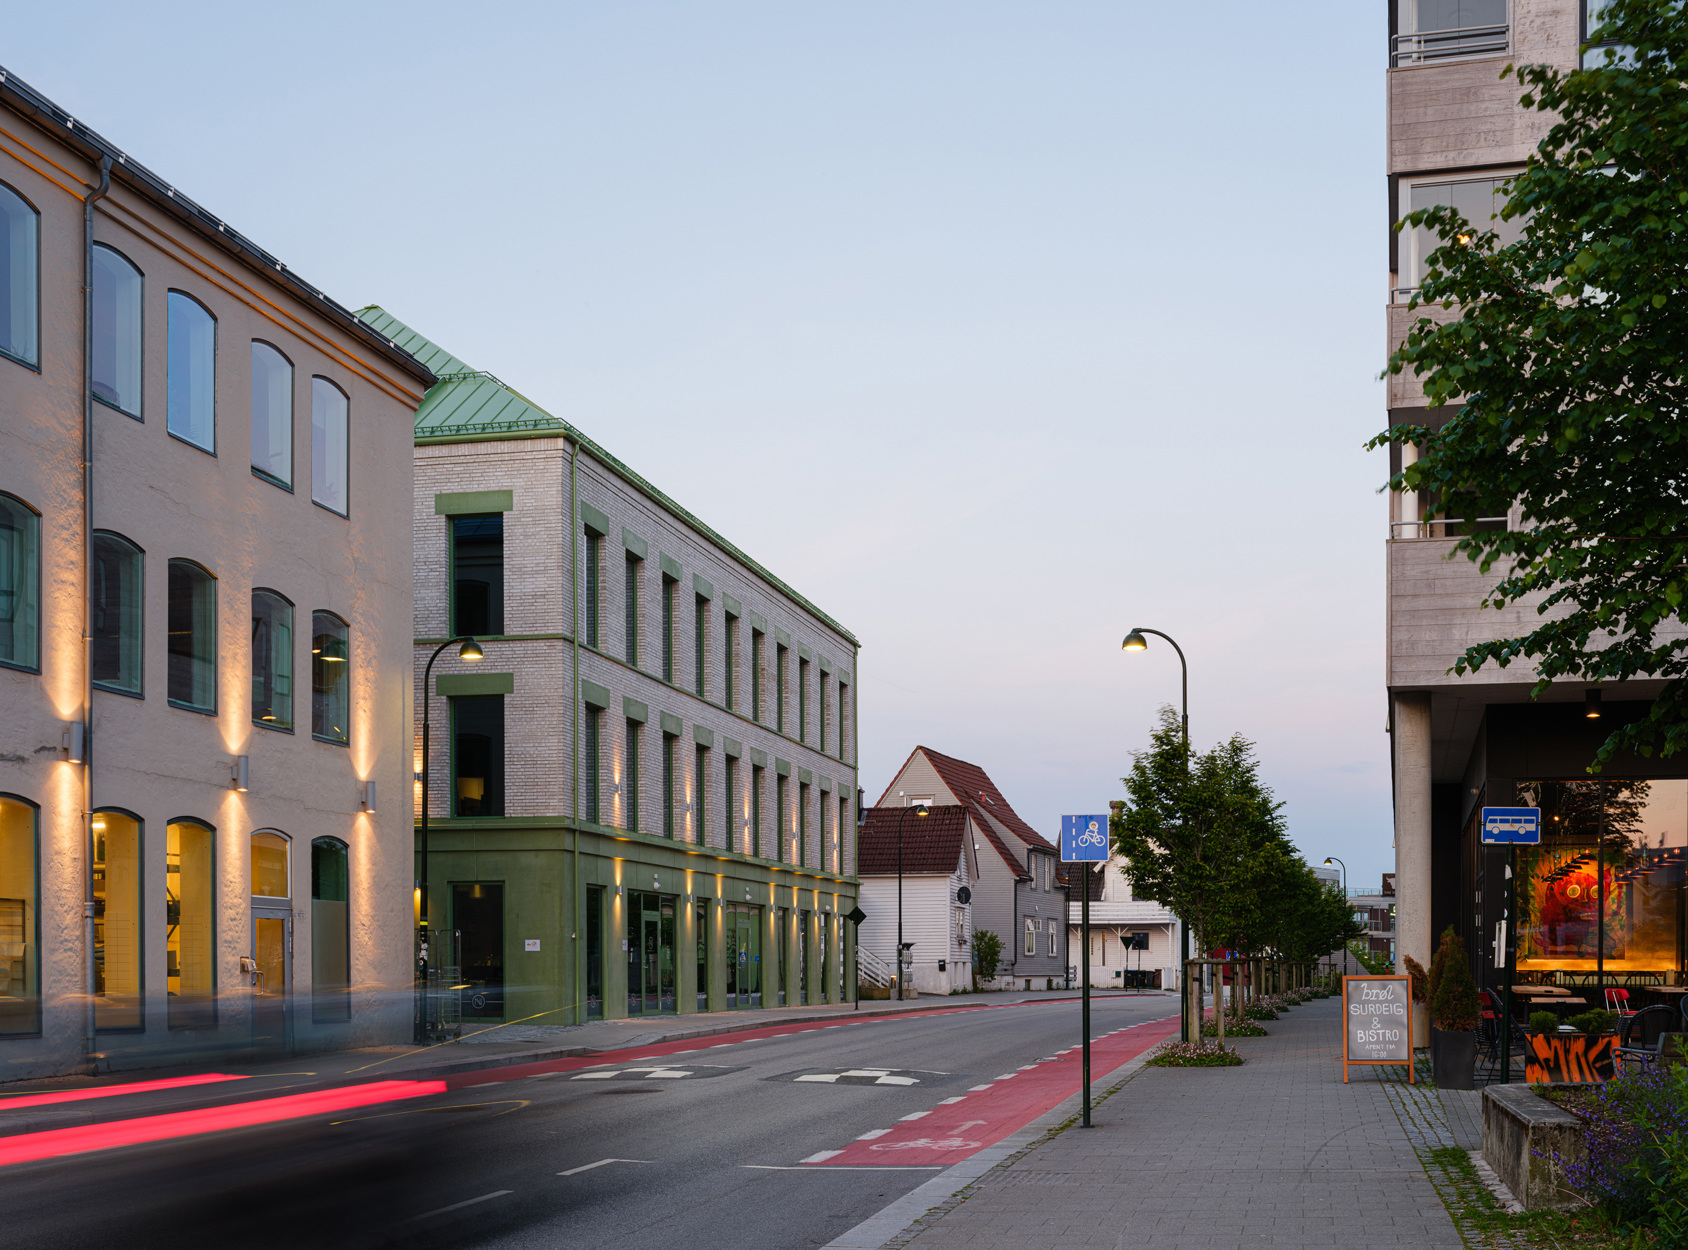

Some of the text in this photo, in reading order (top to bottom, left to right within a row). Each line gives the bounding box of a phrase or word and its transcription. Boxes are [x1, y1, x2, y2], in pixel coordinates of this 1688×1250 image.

[1361, 983, 1394, 1000] brøl
[1351, 1003, 1403, 1015] SURDEIG
[1371, 1017, 1381, 1029] &
[1357, 1030, 1399, 1042] BISTRO
